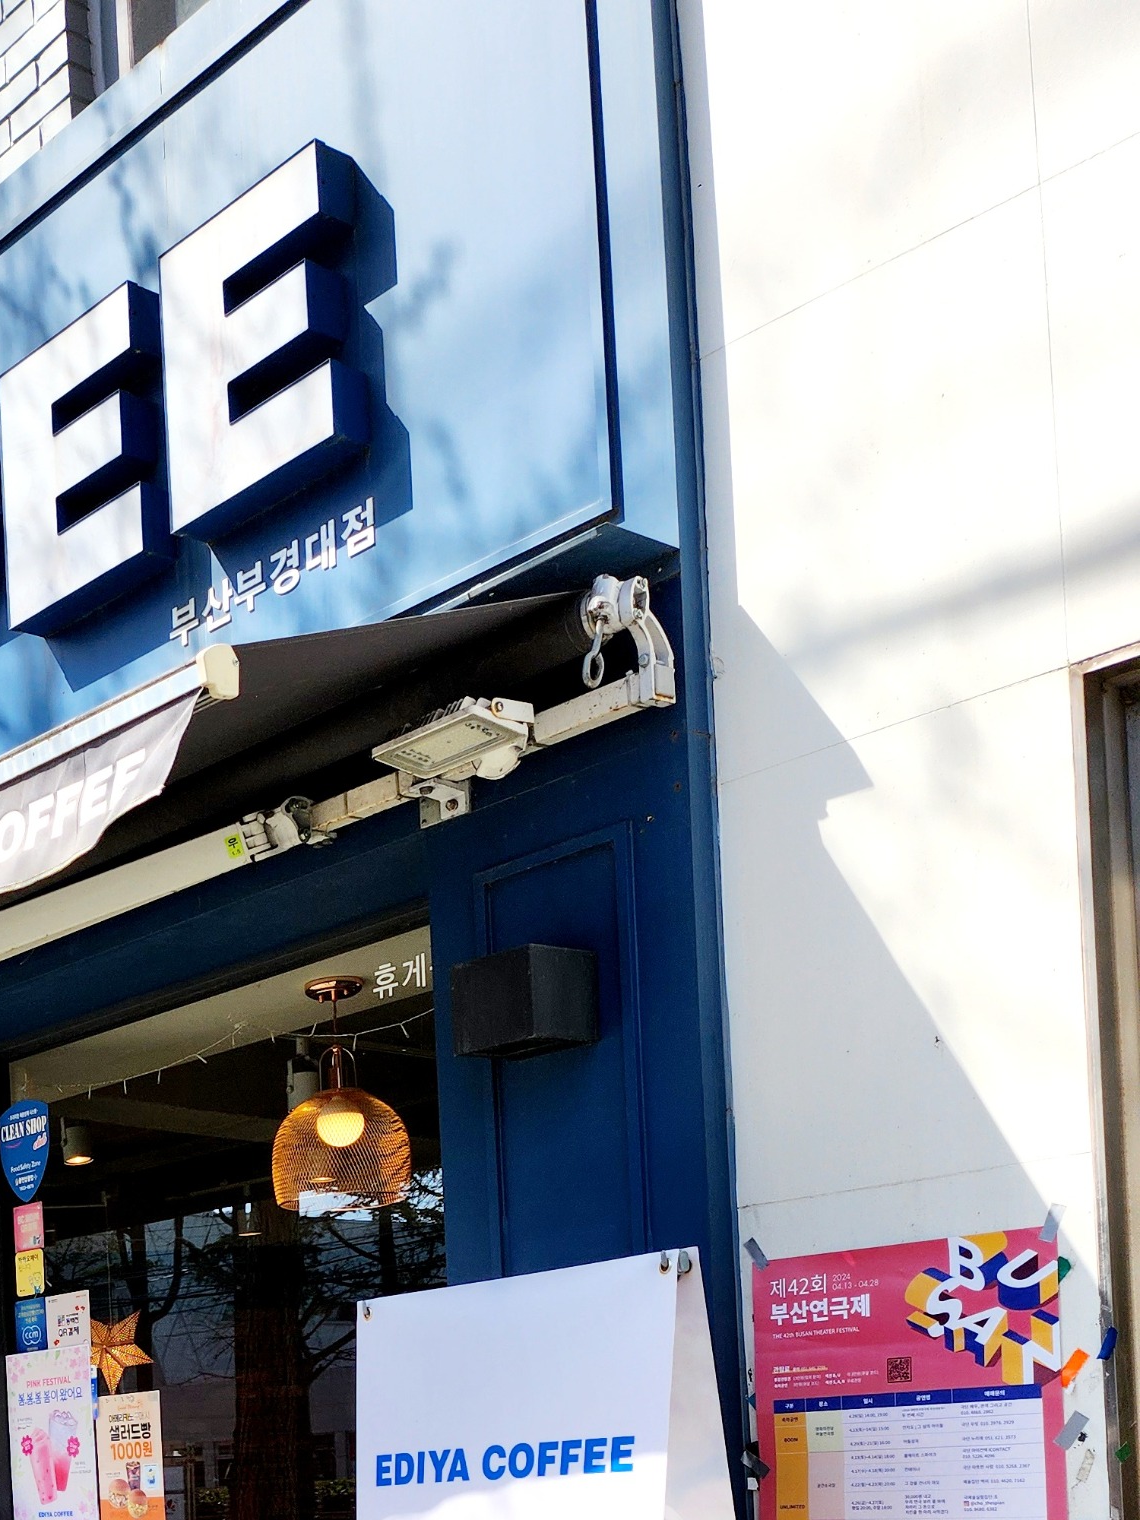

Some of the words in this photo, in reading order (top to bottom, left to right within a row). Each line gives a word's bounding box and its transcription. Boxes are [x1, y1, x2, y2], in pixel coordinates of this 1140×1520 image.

[168, 497, 377, 648] 부산부경대점
[372, 952, 432, 999] 휴게
[0, 1121, 25, 1142] CLEAN
[25, 1116, 47, 1136] SHOP
[769, 1273, 827, 1298] 제42회
[832, 1273, 850, 1281] 2024
[770, 1293, 870, 1326] 부산연극제
[795, 1329, 813, 1338] BUSAN
[813, 1328, 835, 1336] THEATER
[836, 1326, 860, 1334] FESTIVAL
[26, 1378, 41, 1388] PINK
[42, 1376, 71, 1387] FESTIVAL
[109, 1422, 151, 1442] 샐러드빵
[110, 1441, 153, 1461] 1000원
[375, 1448, 470, 1488] EDIYA
[482, 1434, 636, 1482] COFFEE
